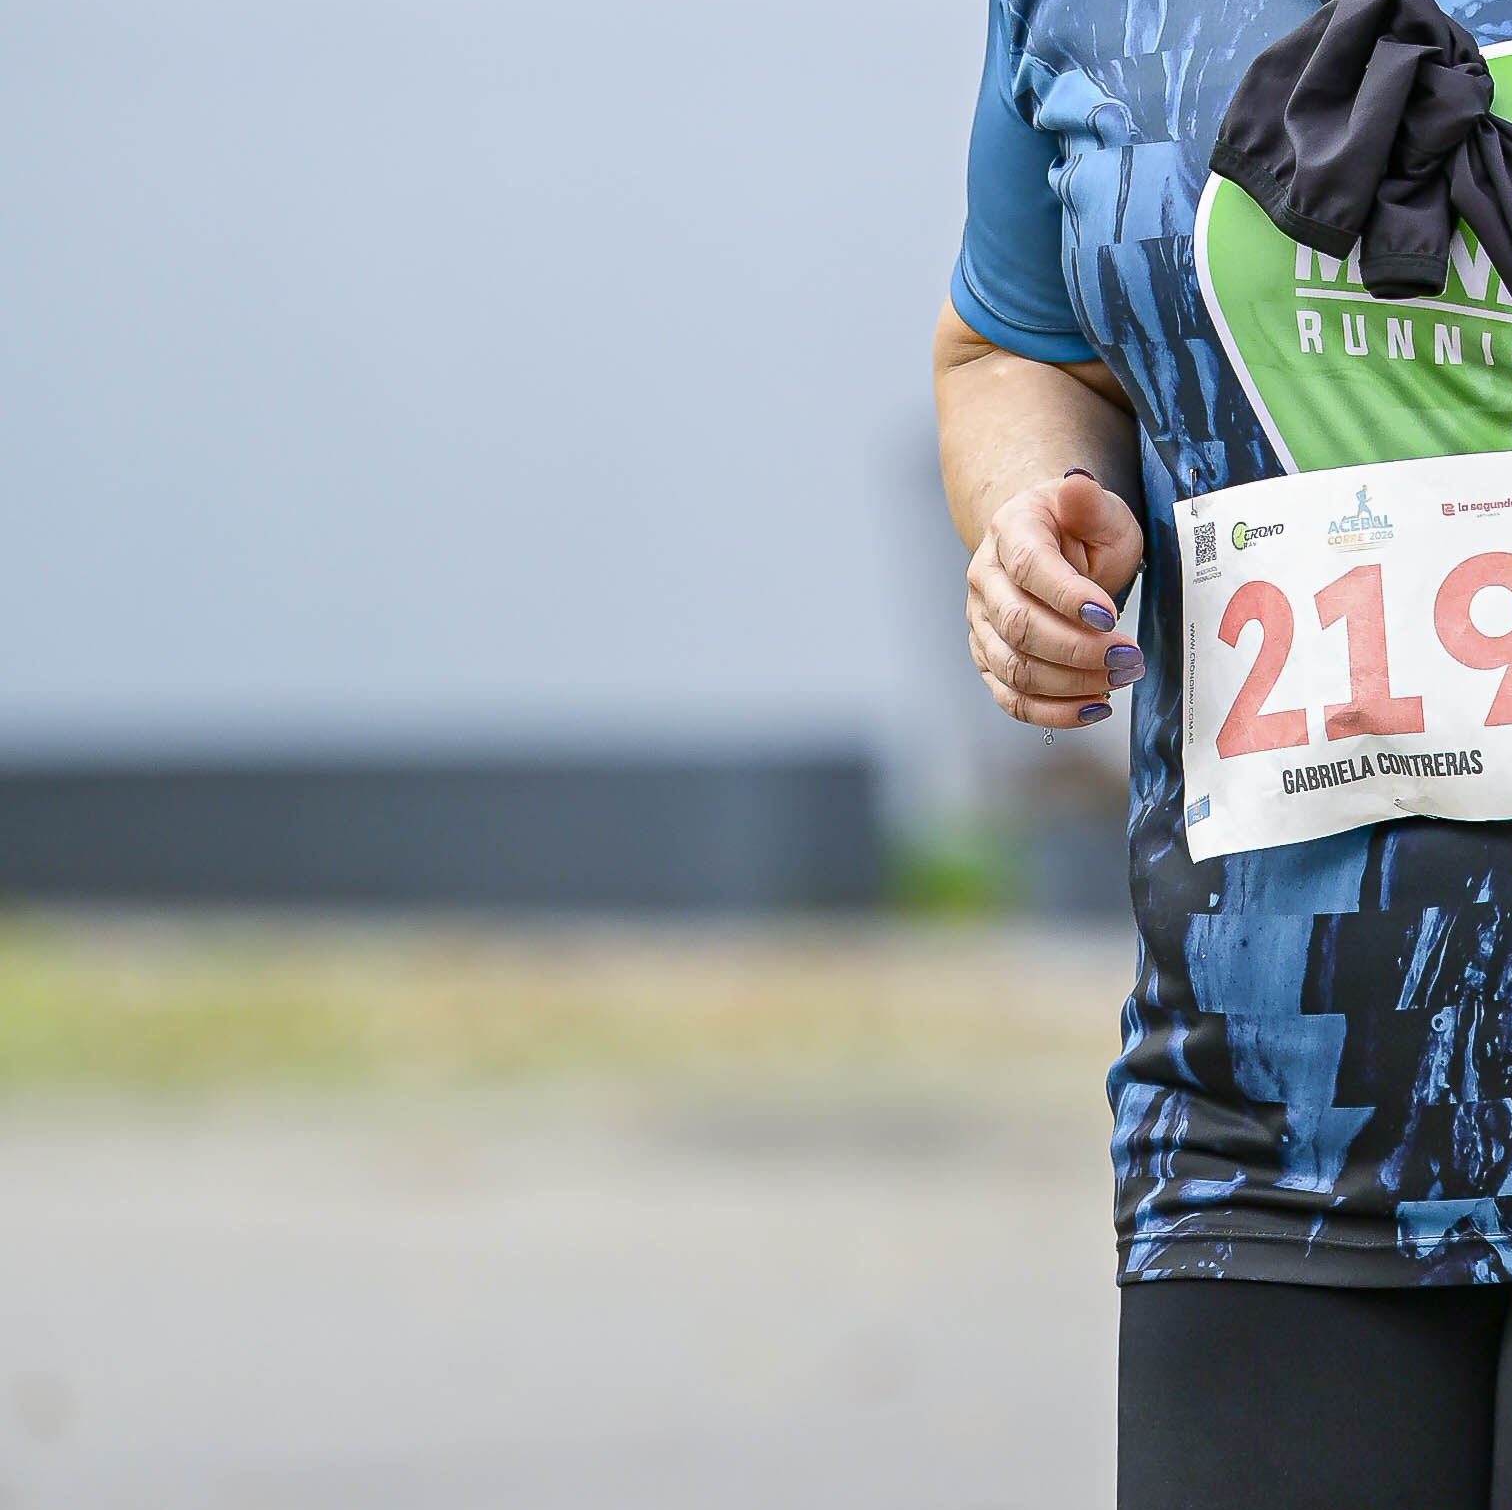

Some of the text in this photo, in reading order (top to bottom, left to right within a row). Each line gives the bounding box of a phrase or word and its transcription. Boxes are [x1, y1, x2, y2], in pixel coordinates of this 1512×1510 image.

[1458, 502, 1469, 512] la
[1328, 514, 1393, 535] ACEBAL
[1282, 749, 1484, 795] GABRIELA CONTRERAS
